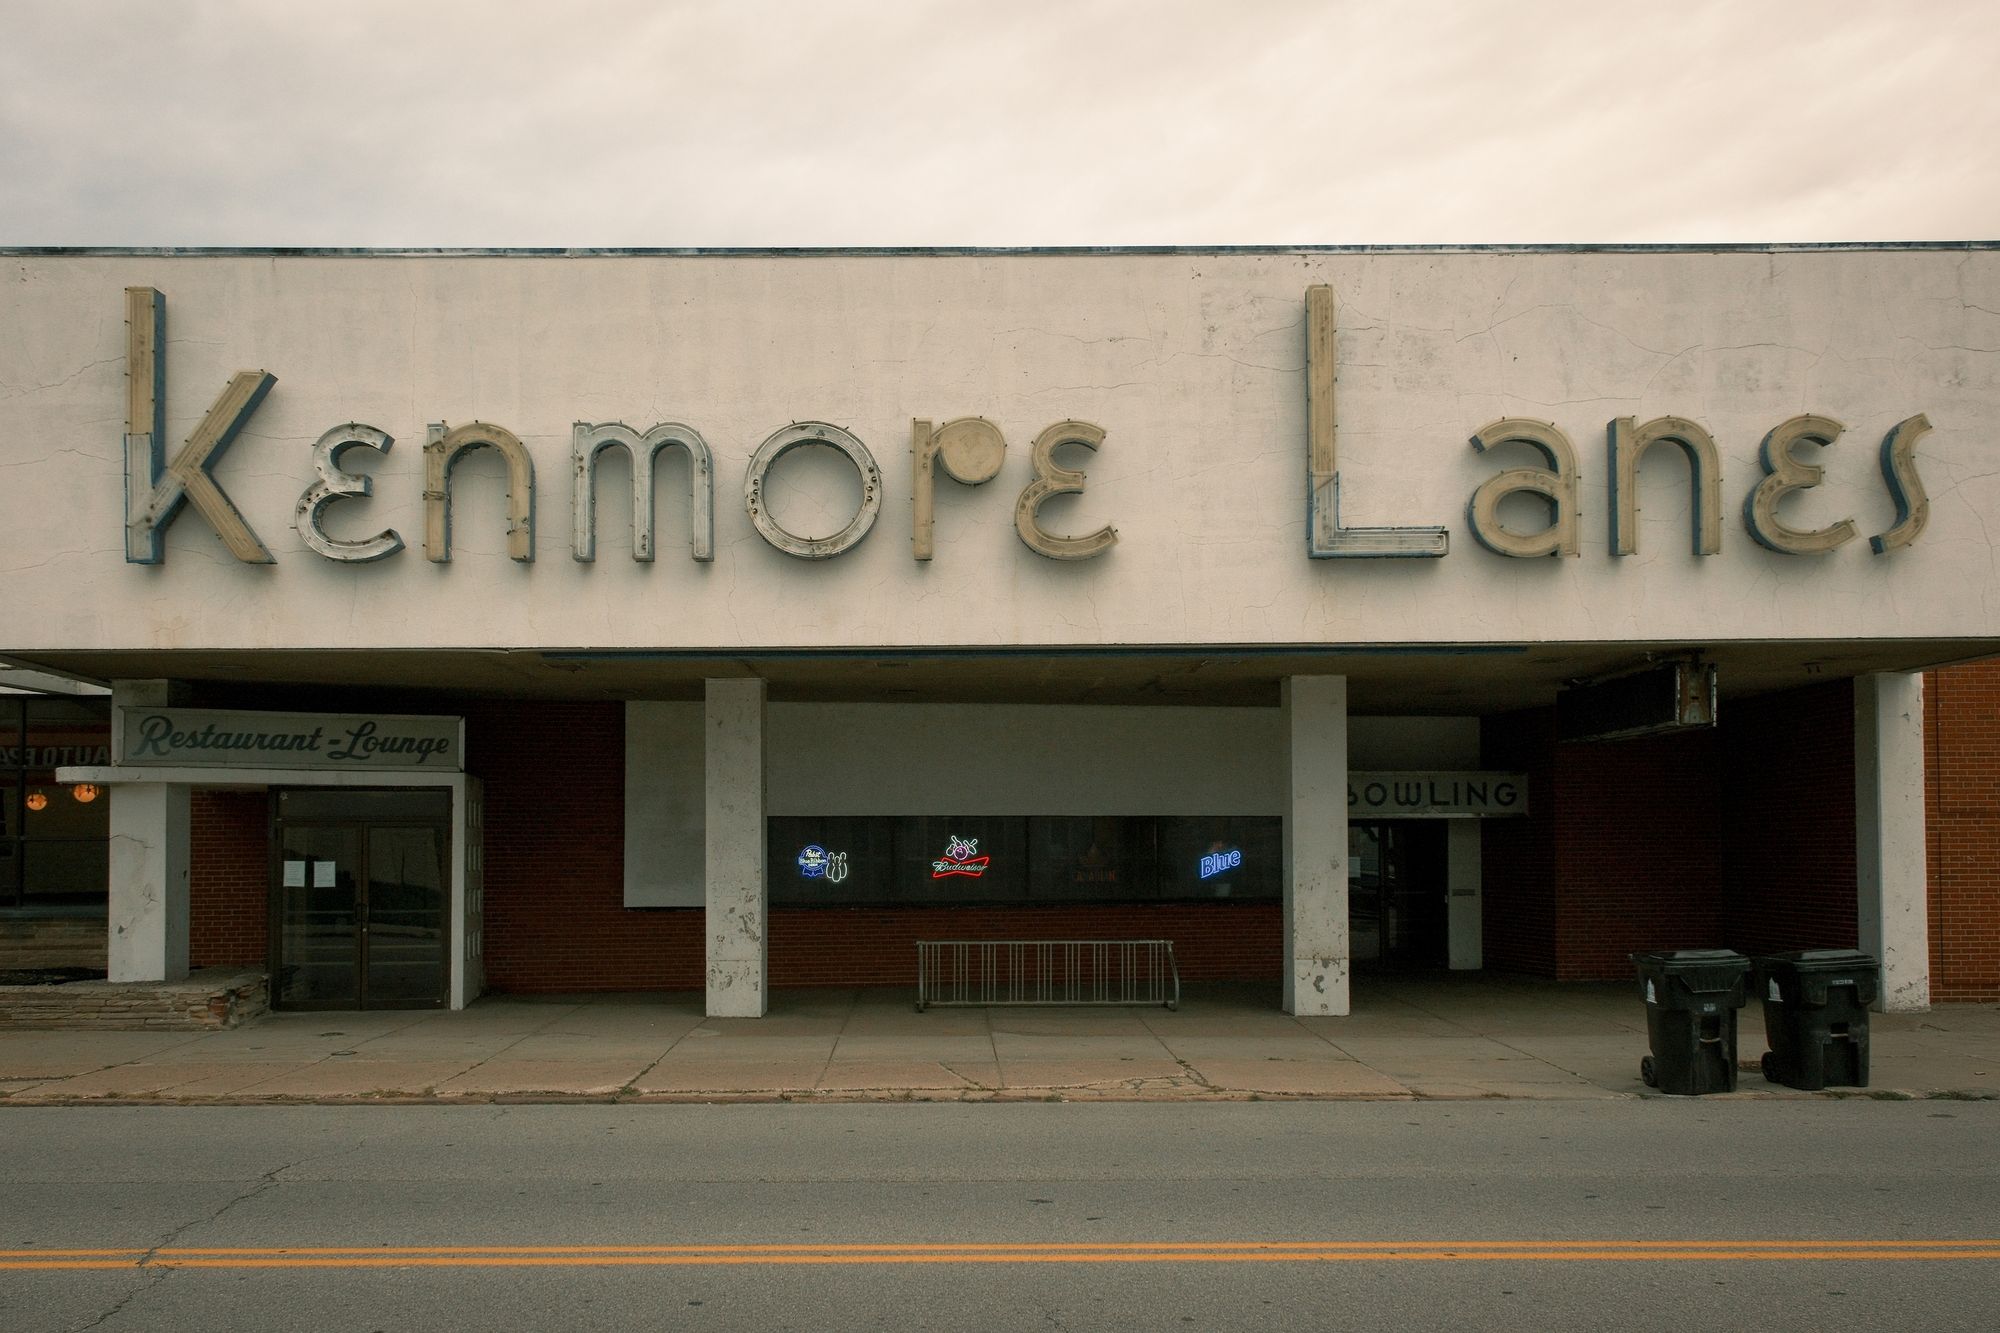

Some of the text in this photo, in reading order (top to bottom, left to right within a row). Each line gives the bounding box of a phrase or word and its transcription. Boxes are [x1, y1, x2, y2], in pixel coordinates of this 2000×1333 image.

[124, 283, 1932, 565] Kenmore Lanes
[130, 715, 323, 756] Restaurant
[932, 860, 988, 872] Budweiser
[1200, 850, 1241, 879] Blue
